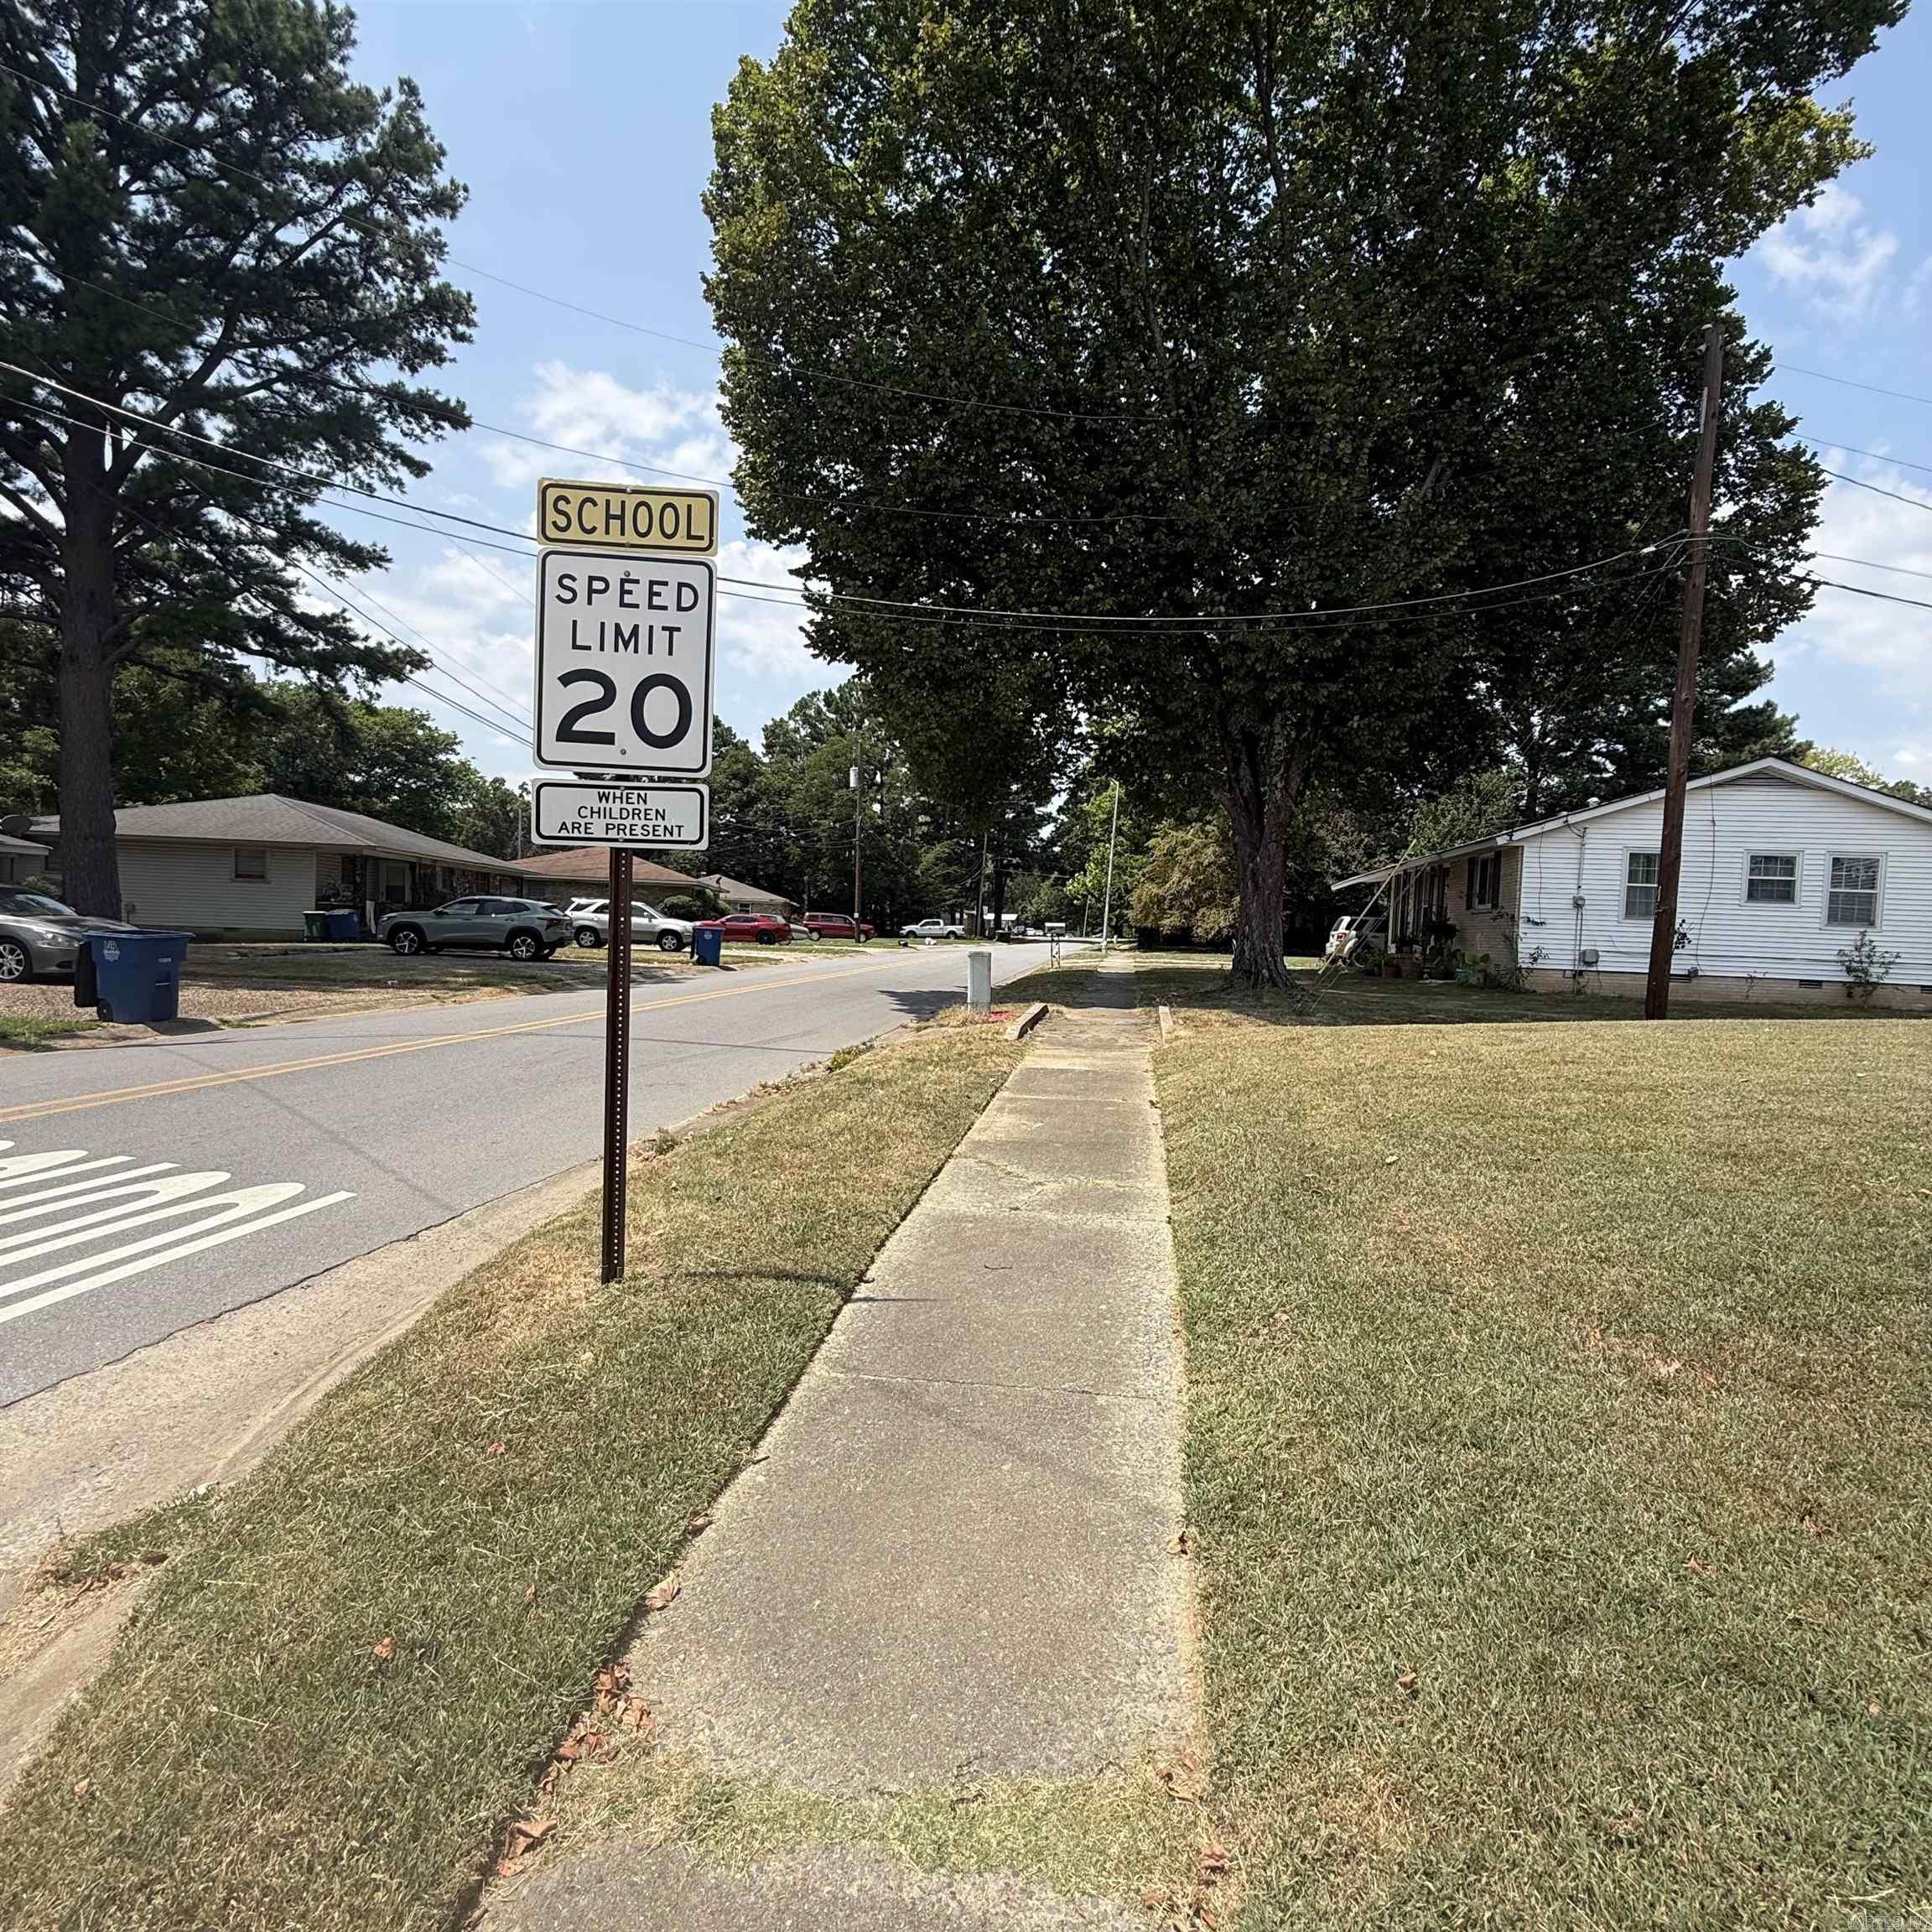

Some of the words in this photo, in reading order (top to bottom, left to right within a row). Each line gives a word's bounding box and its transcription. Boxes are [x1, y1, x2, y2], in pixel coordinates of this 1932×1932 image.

[551, 494, 705, 541] SCHOOL
[555, 573, 699, 612] SPEED
[571, 619, 682, 657] LIMIT
[555, 668, 693, 749] 20
[577, 805, 666, 821] CHILDREN
[597, 791, 647, 805] WHEN
[558, 821, 594, 835] ARE
[605, 823, 684, 838] PRESENT
